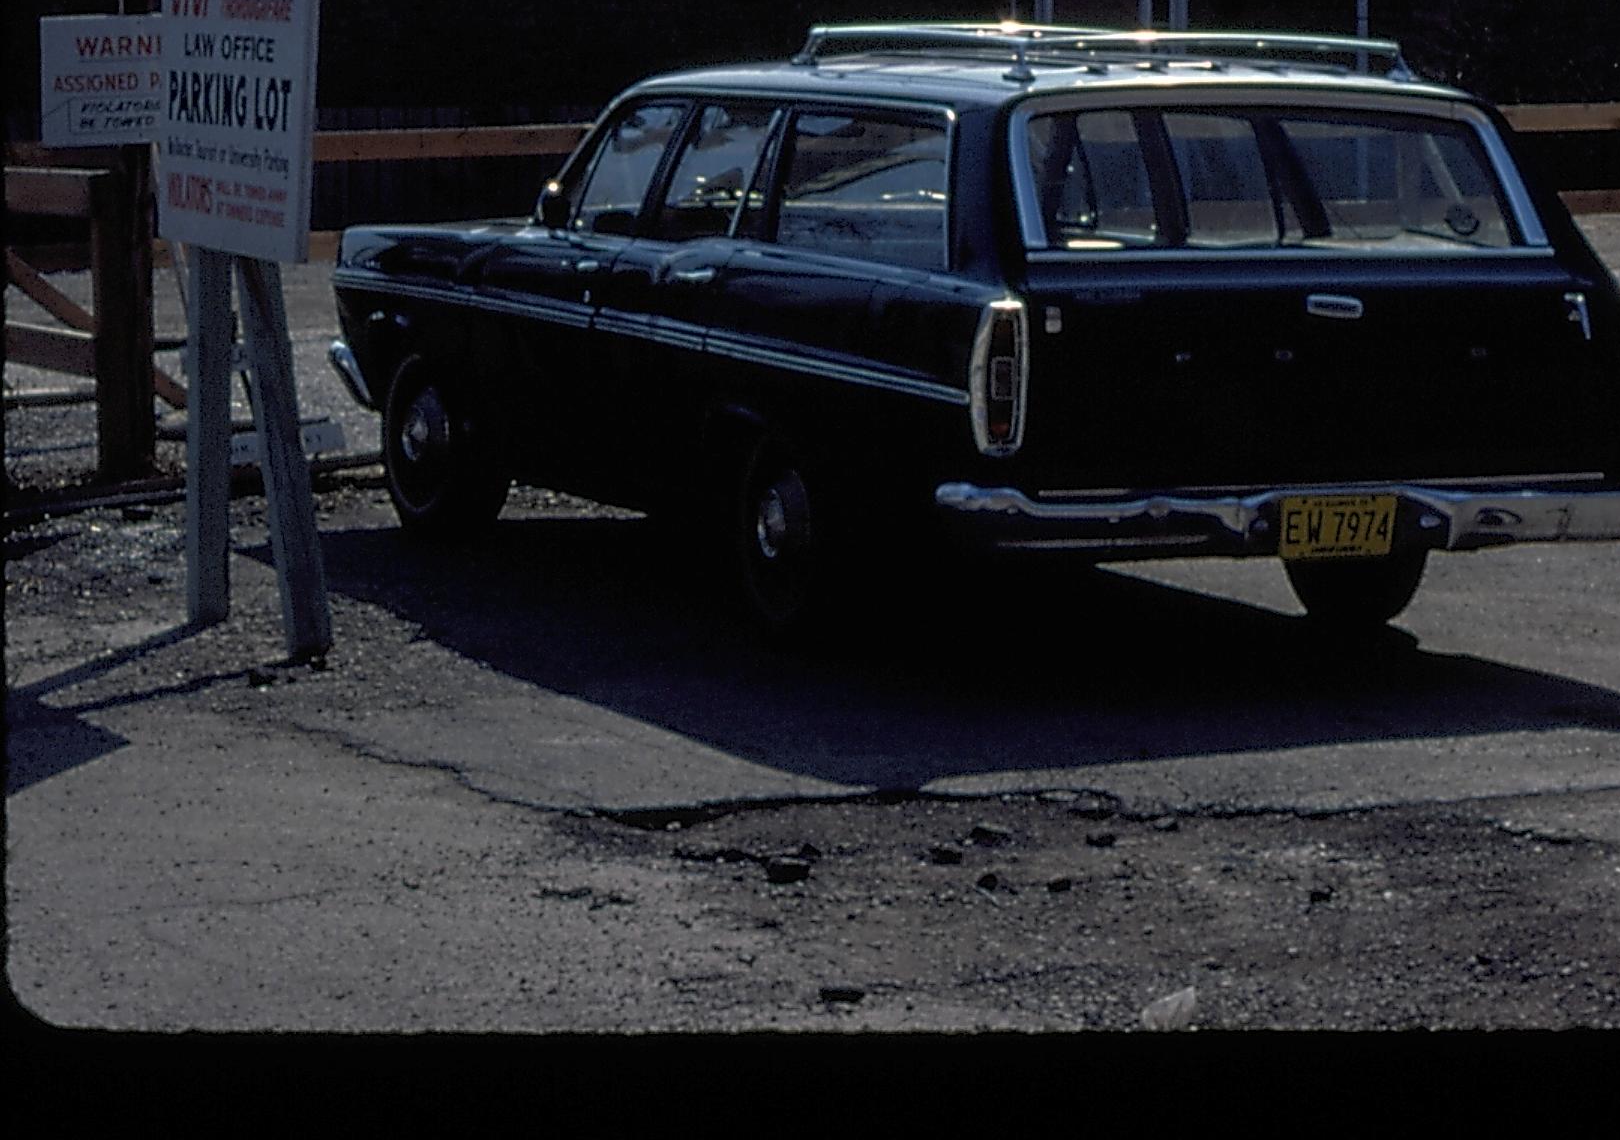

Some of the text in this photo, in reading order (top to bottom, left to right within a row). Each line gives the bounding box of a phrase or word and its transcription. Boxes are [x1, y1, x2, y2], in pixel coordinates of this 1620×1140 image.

[184, 33, 275, 63] LAW OFFICE
[53, 73, 139, 93] ASSIGNED
[168, 70, 293, 132] PARKING LOT
[103, 115, 155, 129] TOWED
[1286, 510, 1389, 545] EW 7974
